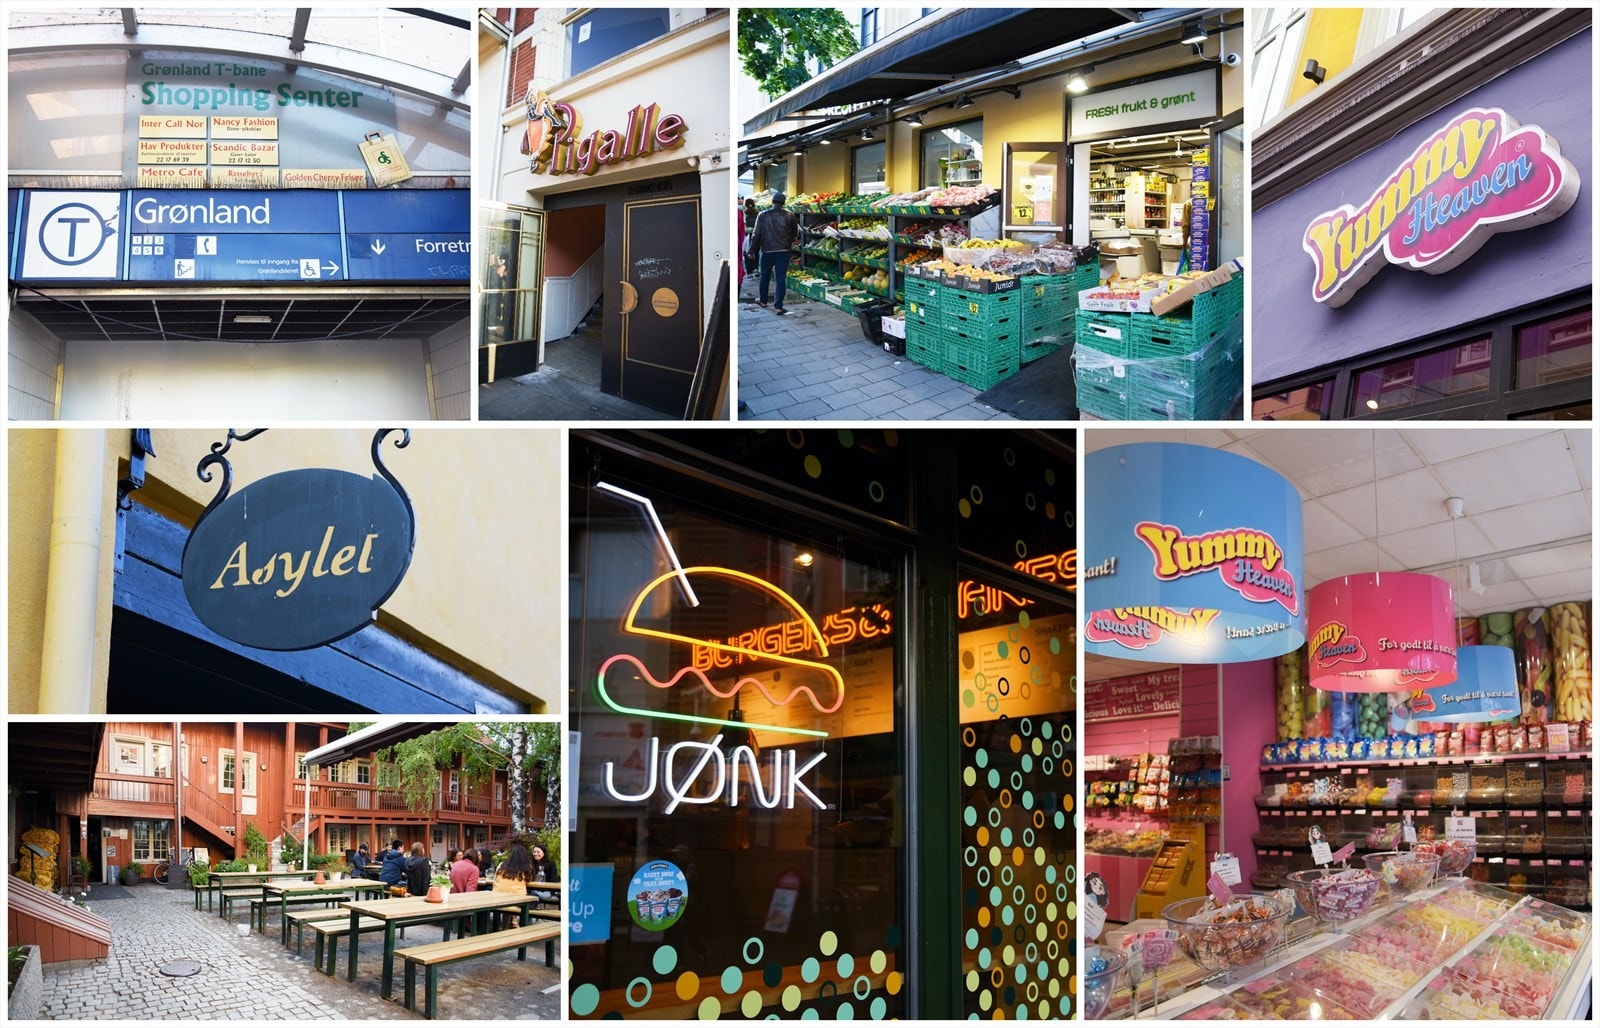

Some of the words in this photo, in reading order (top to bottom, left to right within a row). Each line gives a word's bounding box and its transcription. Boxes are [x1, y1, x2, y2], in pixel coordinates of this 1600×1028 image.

[141, 63, 211, 77] Grønland
[214, 63, 266, 76] T-bane
[141, 81, 271, 111] Shopping
[277, 83, 363, 109] Senter
[1085, 105, 1119, 120] FRESH
[1121, 99, 1147, 114] frukt
[1150, 98, 1158, 108] &
[1160, 91, 1196, 109] grønt
[141, 119, 162, 128] Inter
[165, 119, 183, 128] Call
[186, 119, 204, 128] Nor
[213, 118, 240, 127] Nancy
[243, 118, 276, 126] Fashion
[141, 142, 157, 150] Hav
[160, 142, 204, 150] Produkter
[522, 102, 688, 176] Pigalle
[212, 143, 247, 152] Scandic
[251, 144, 276, 152] Bazar
[141, 168, 175, 177] Metro
[179, 168, 204, 177] Cafe
[284, 173, 311, 181] Golden
[313, 174, 339, 183] Cherry
[341, 174, 364, 182] Frisør
[1309, 118, 1496, 293] Yummy
[1402, 153, 1532, 246] Heaven
[134, 197, 270, 225] Grønland
[58, 217, 97, 258] T
[1140, 526, 1282, 576] Yummy
[209, 525, 379, 598] Asylet
[1232, 560, 1293, 598] Heaven
[1378, 637, 1399, 651] For
[1400, 640, 1422, 651] godt
[1423, 640, 1433, 650] til
[1320, 643, 1358, 660] Heaven
[1147, 675, 1161, 686] My
[1111, 685, 1138, 695] Sweet
[1135, 690, 1165, 702] Lovely
[1441, 693, 1455, 704] For
[1455, 693, 1471, 703] godt
[1471, 691, 1480, 699] til
[1112, 706, 1133, 715] Love
[1133, 704, 1144, 713] it!
[601, 733, 829, 815] JØNK
